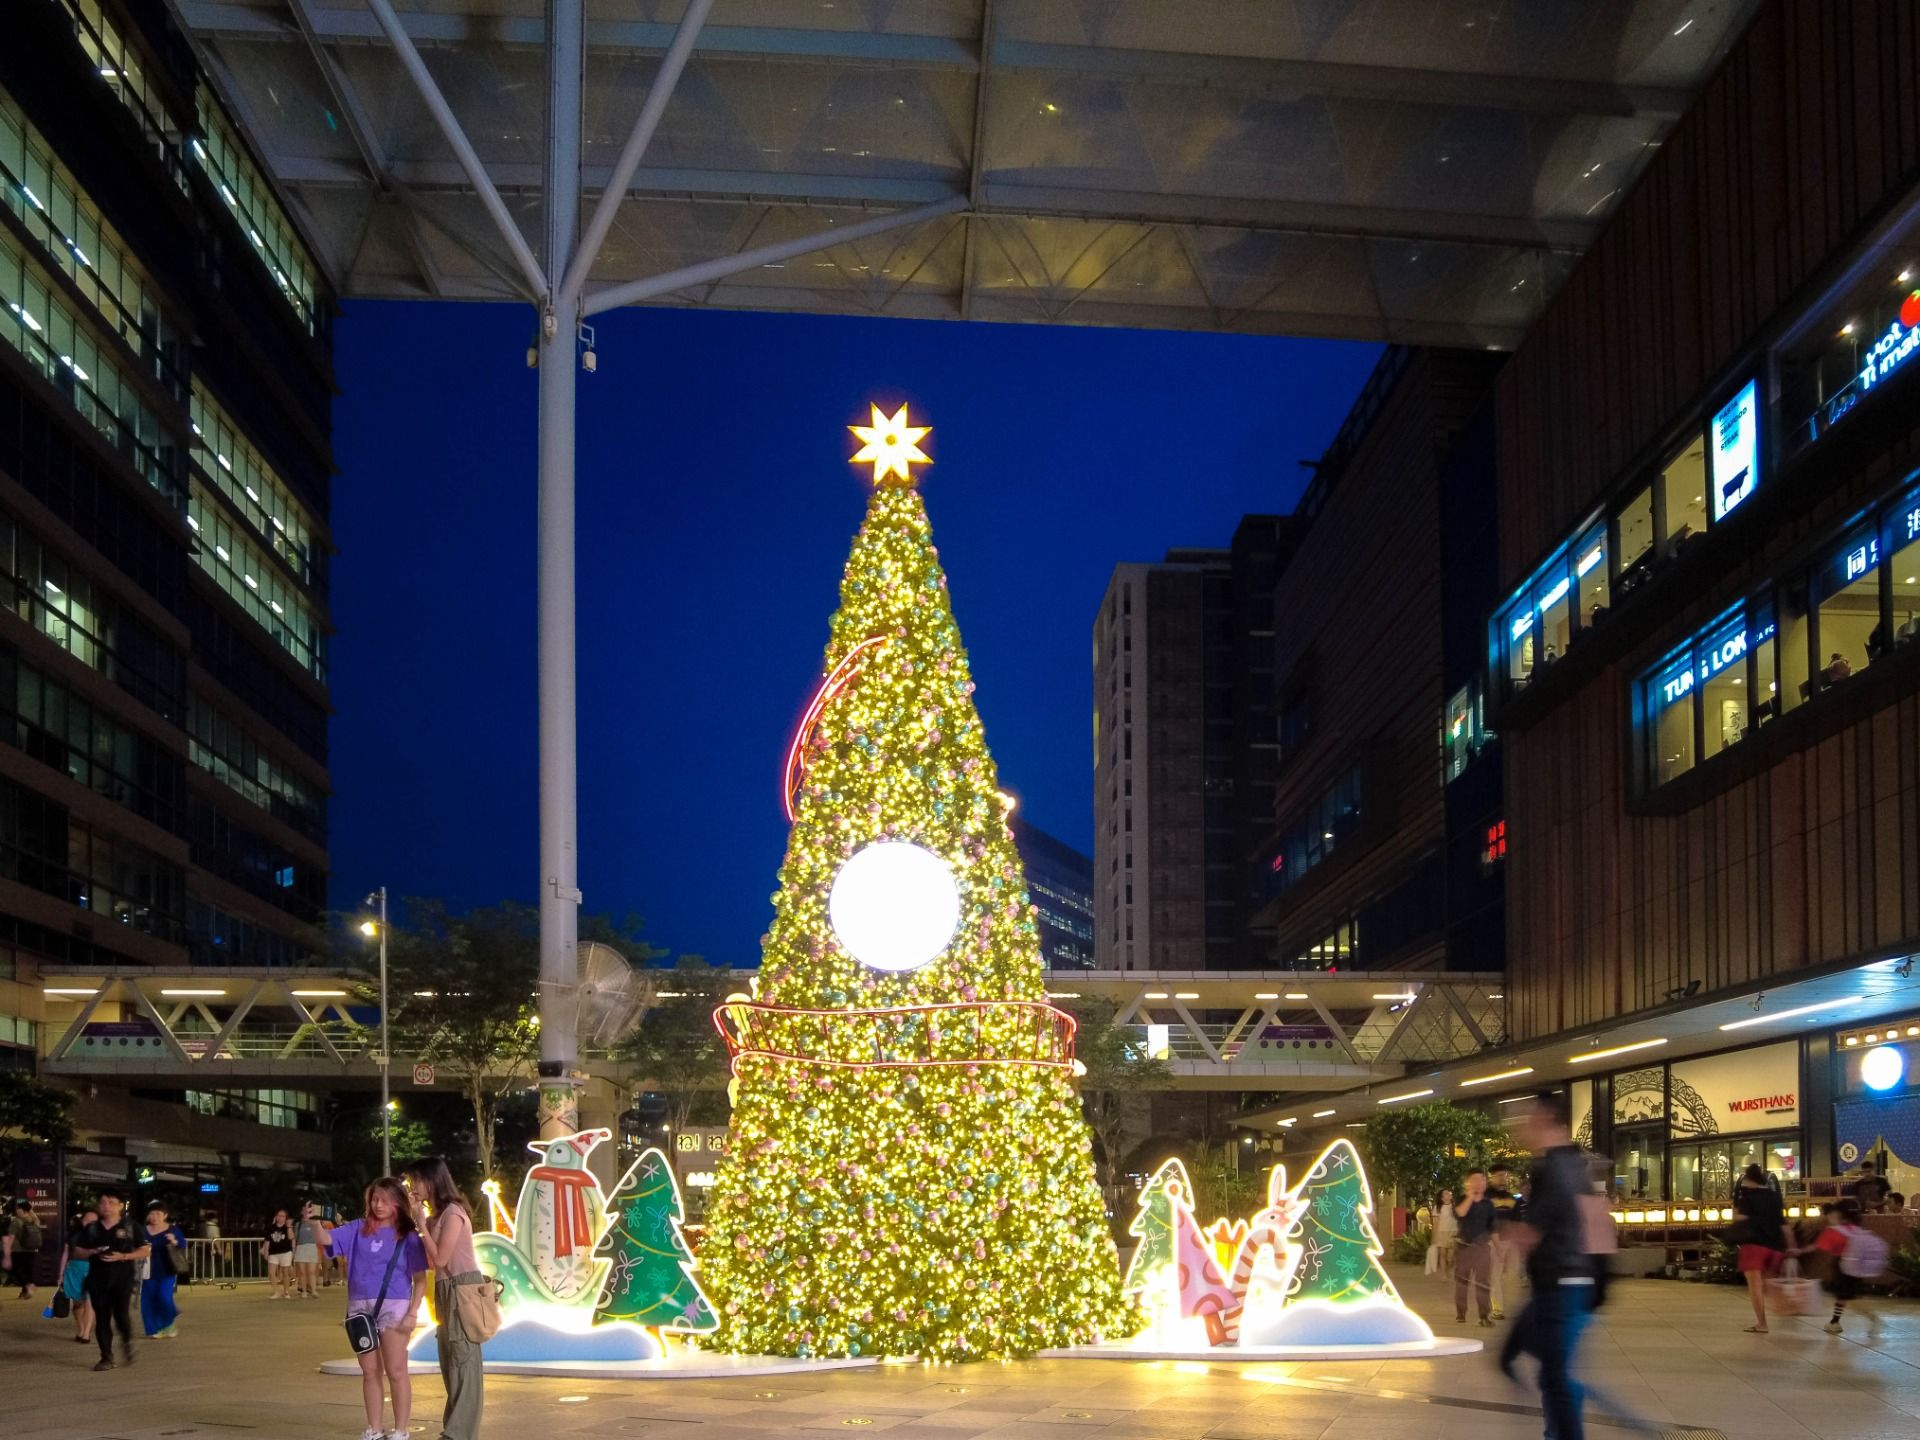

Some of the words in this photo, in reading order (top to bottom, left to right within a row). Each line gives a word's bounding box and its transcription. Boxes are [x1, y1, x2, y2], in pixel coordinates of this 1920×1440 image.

[1866, 322, 1902, 366] Hot
[1719, 406, 1748, 437] SEAFOOD
[1720, 430, 1739, 452] STEAK
[1712, 630, 1748, 671] LOK
[1728, 1094, 1795, 1113] WURSTHANS
